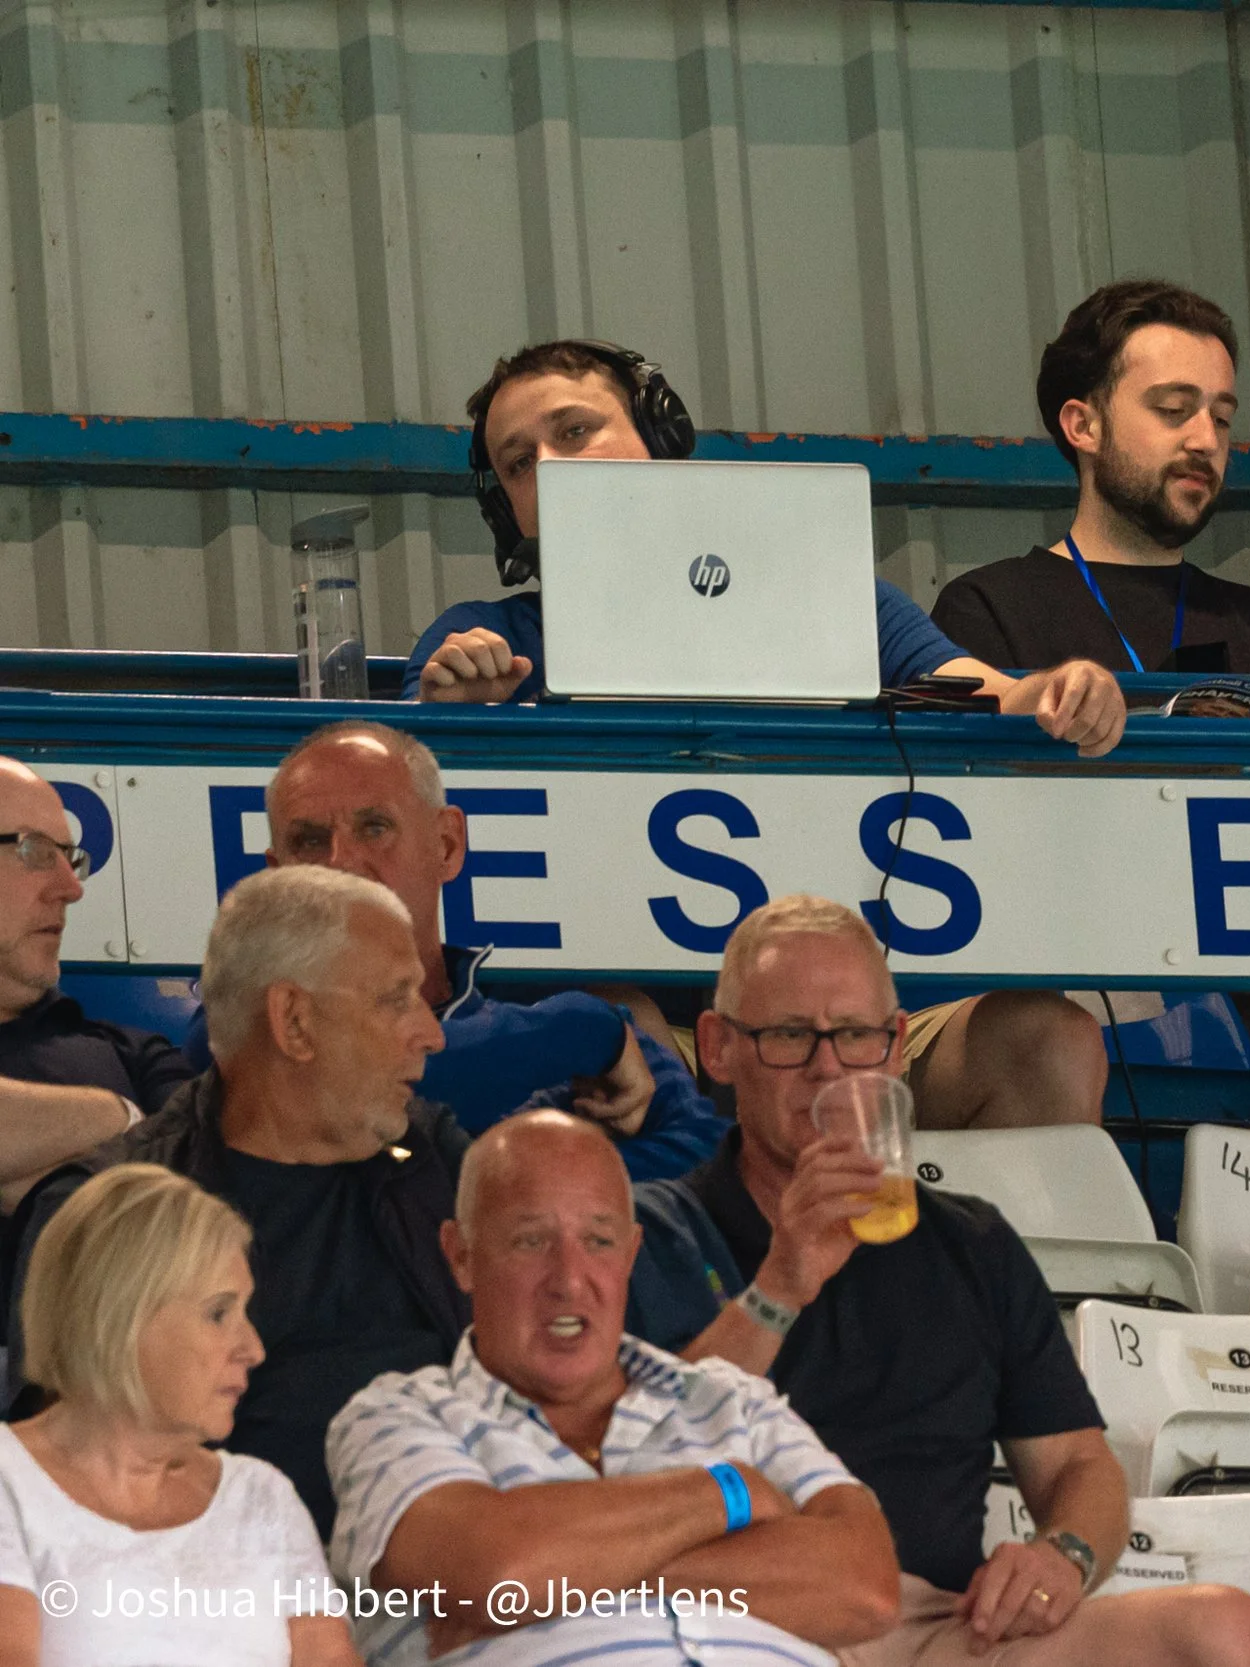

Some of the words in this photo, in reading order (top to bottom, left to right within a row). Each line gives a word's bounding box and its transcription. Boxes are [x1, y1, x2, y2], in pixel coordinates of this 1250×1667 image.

[694, 553, 727, 598] hp
[920, 1166, 938, 1179] 13
[1111, 1318, 1143, 1367] 13
[1232, 1352, 1250, 1366] 13
